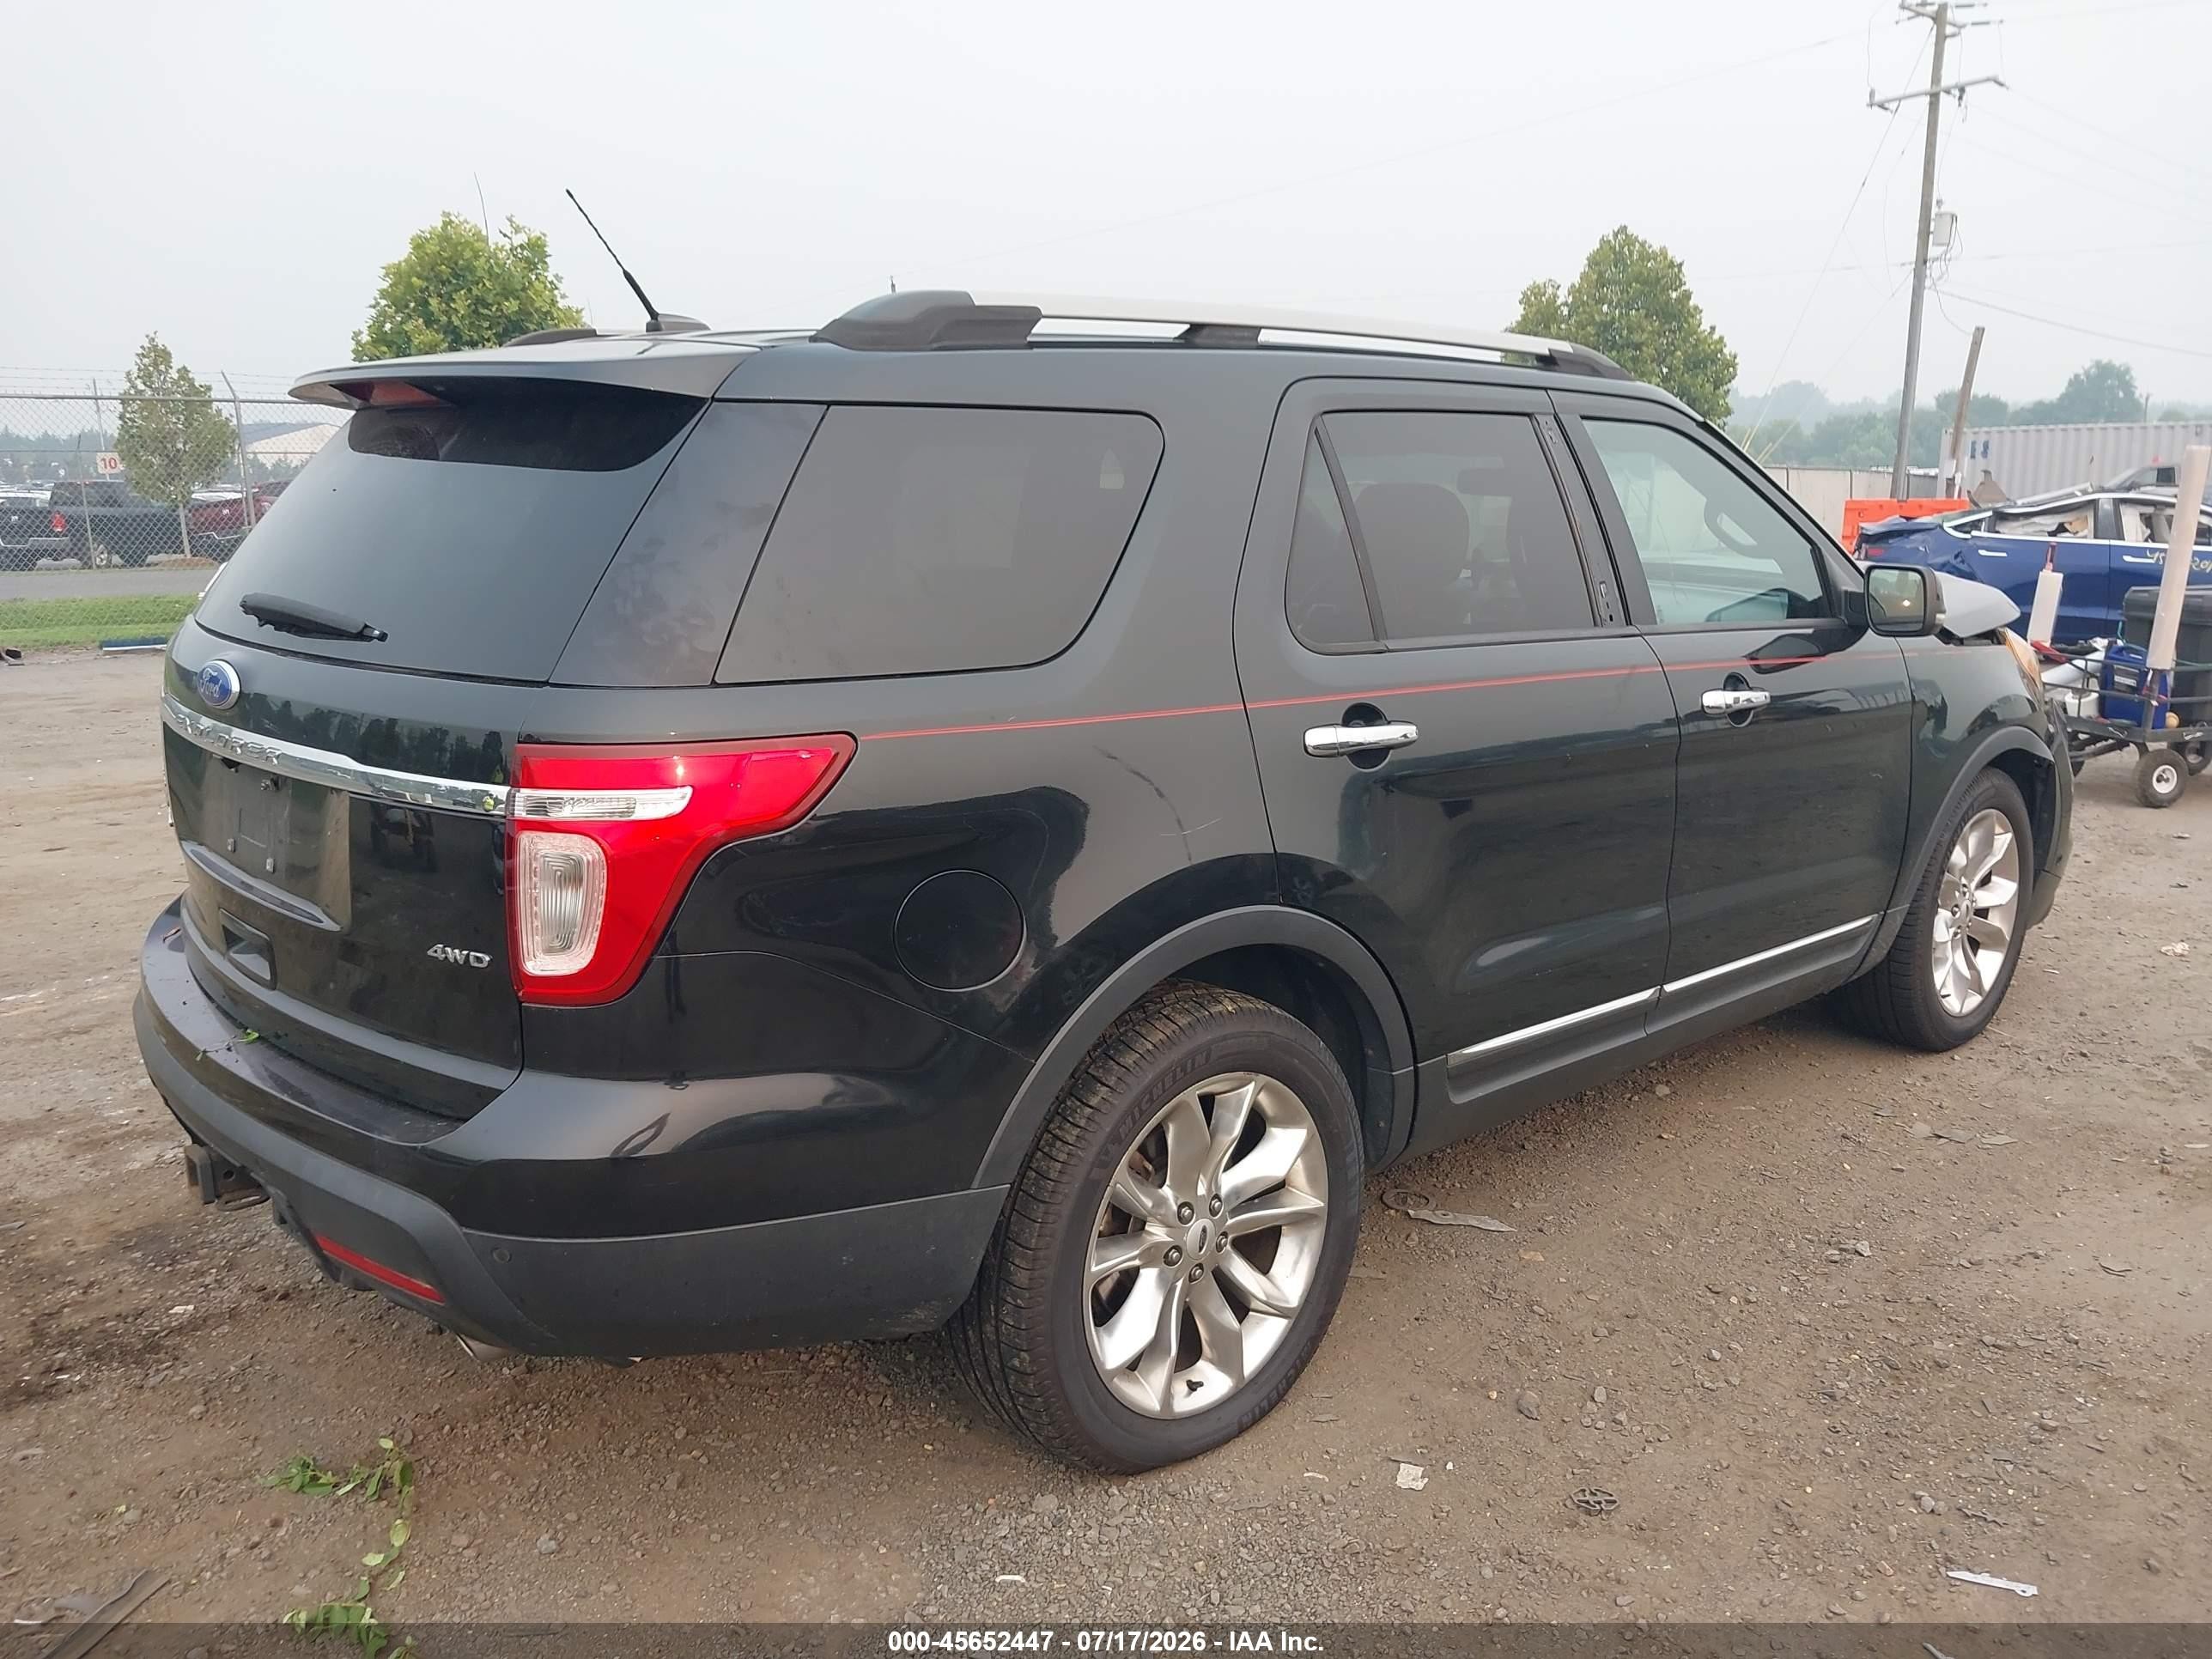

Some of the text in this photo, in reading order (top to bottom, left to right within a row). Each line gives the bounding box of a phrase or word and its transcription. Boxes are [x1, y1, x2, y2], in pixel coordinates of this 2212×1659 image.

[100, 457, 118, 470] 10
[198, 667, 222, 698] Ford
[175, 714, 282, 765] EXPLORER
[427, 944, 492, 969] 4WD
[1118, 1043, 1212, 1140] MICHELIN
